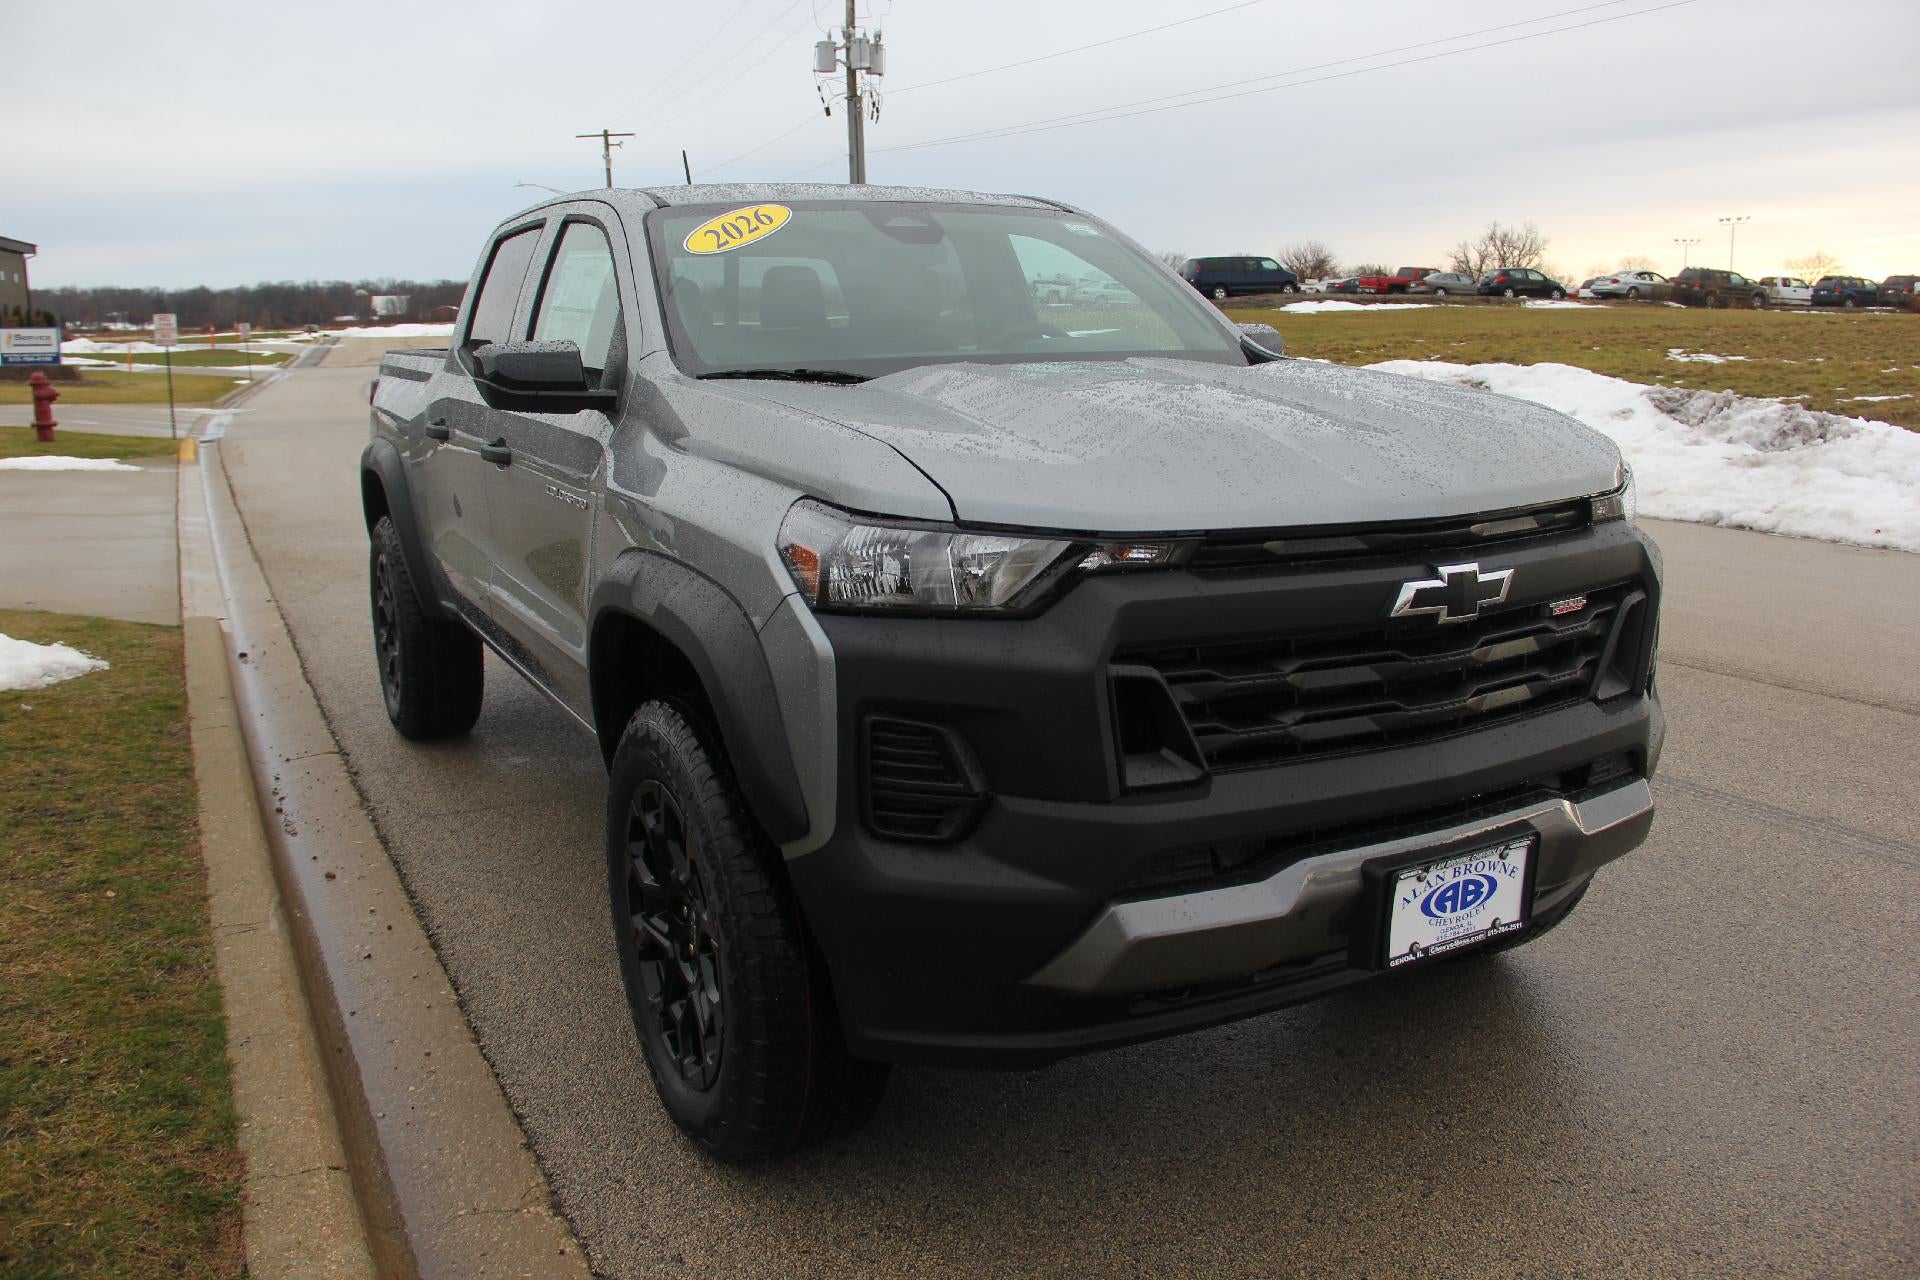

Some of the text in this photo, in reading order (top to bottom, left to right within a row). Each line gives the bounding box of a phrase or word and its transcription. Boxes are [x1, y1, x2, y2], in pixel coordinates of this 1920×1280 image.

[703, 208, 774, 249] 2026
[1401, 871, 1446, 909] ALAN
[1452, 860, 1520, 879] BROWNE
[1428, 904, 1487, 927] CHEVROLET
[1389, 953, 1416, 967] GENOA,
[1416, 950, 1424, 958] IL
